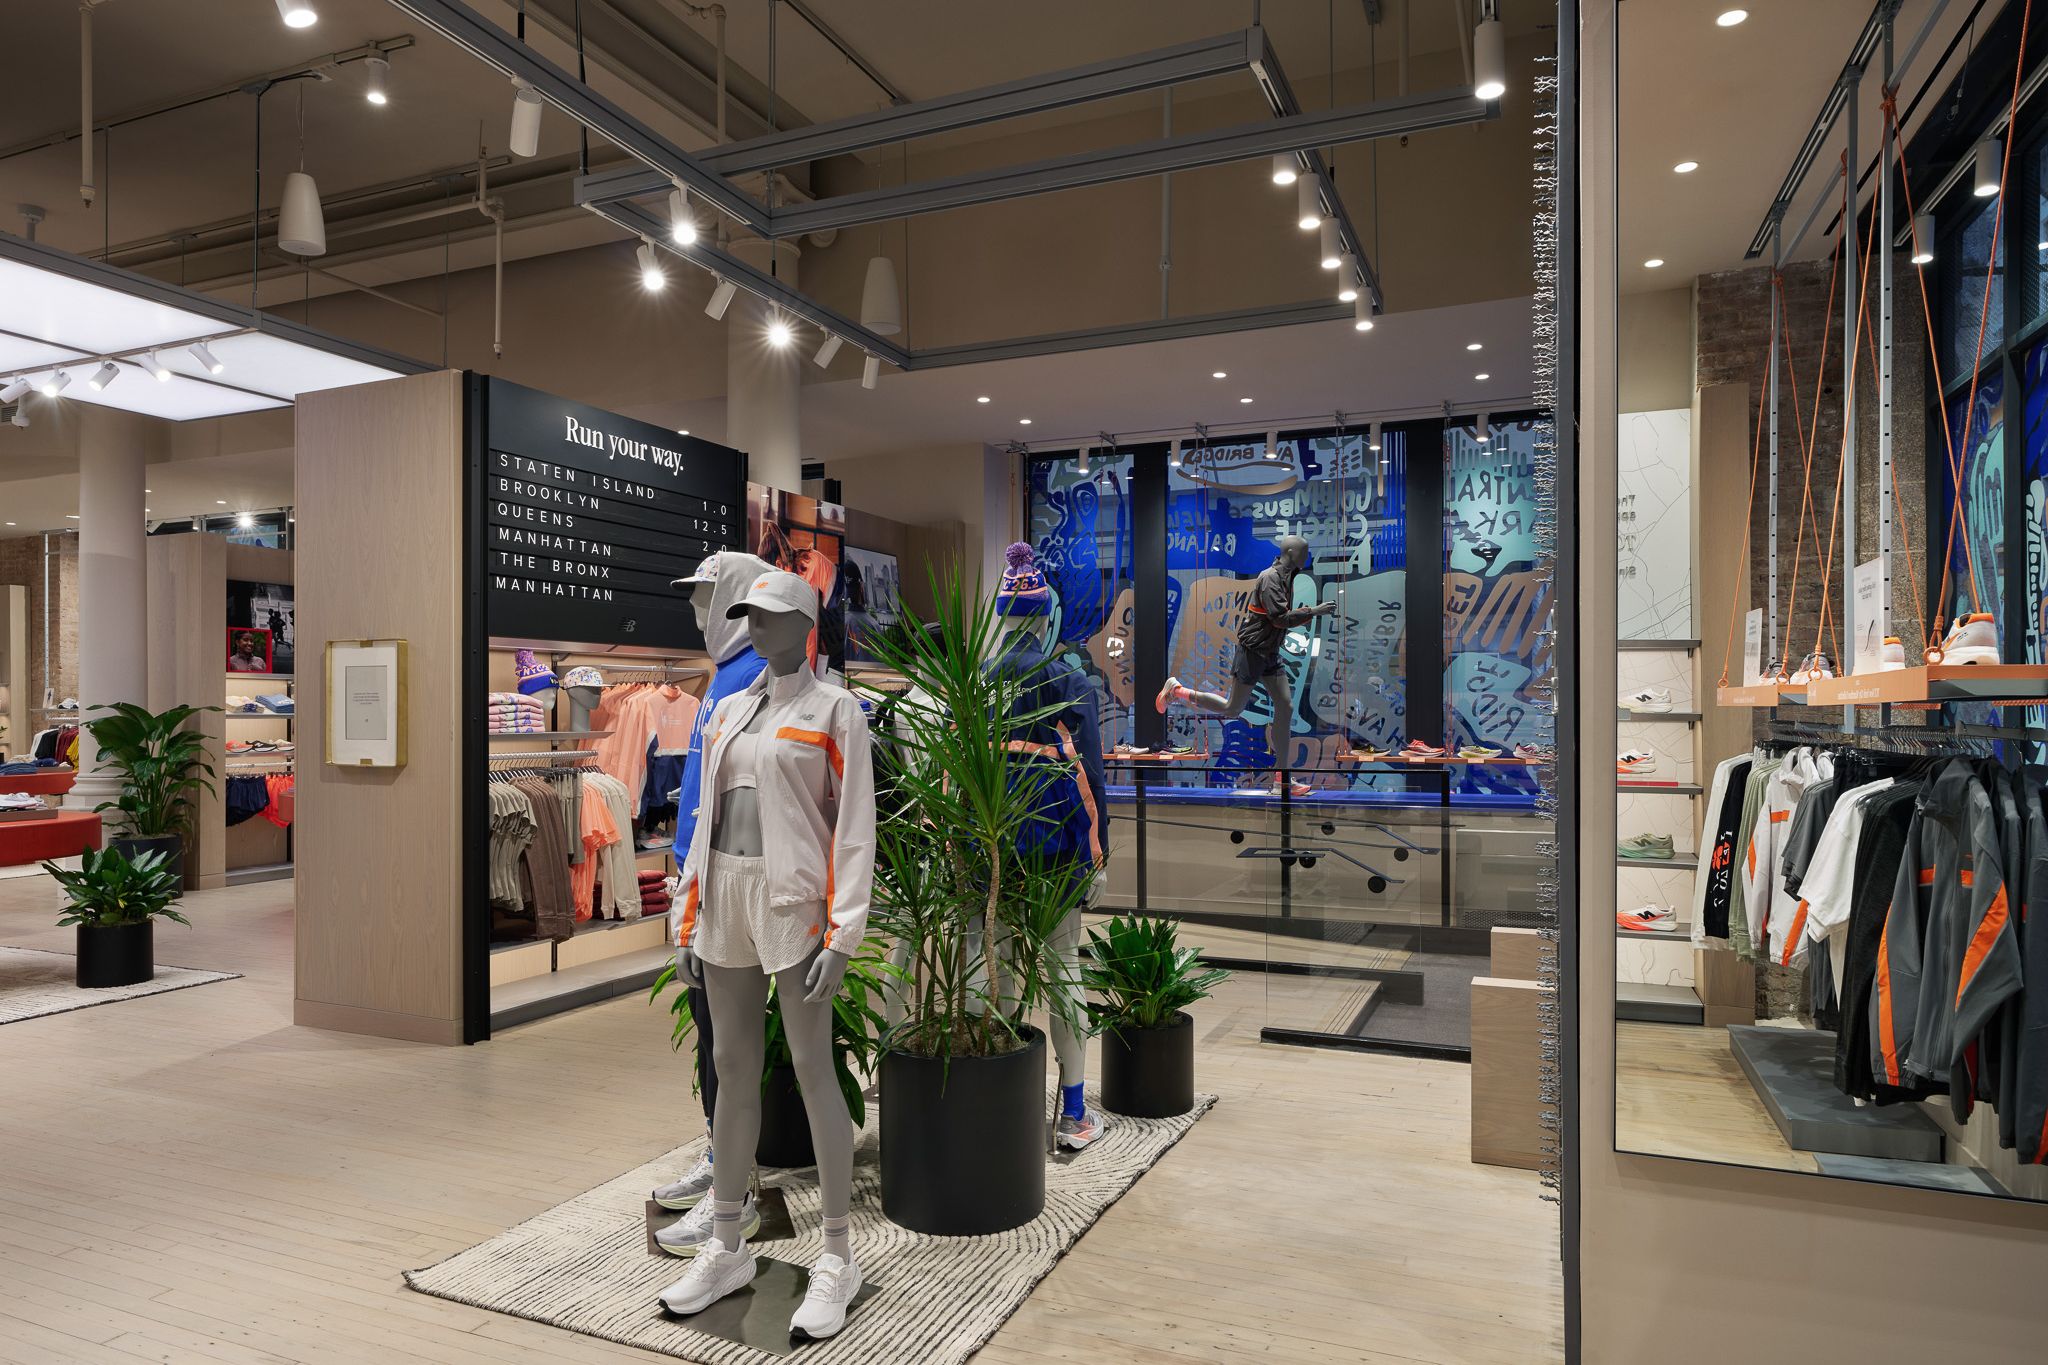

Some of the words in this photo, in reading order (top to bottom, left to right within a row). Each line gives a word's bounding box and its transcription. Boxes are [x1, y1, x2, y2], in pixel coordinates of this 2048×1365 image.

[564, 415, 605, 451] Run
[607, 432, 648, 461] your
[651, 444, 684, 476] way.
[499, 454, 576, 483] STATEN
[592, 475, 655, 500] ISLAND
[499, 478, 600, 511] BROOKLYN
[497, 502, 575, 528] QUEENS
[693, 519, 728, 536] 12.5
[498, 527, 613, 557] MANHATTAN
[500, 553, 537, 569] THE
[552, 560, 610, 579] BRONX
[495, 576, 613, 602] MANHATTAN
